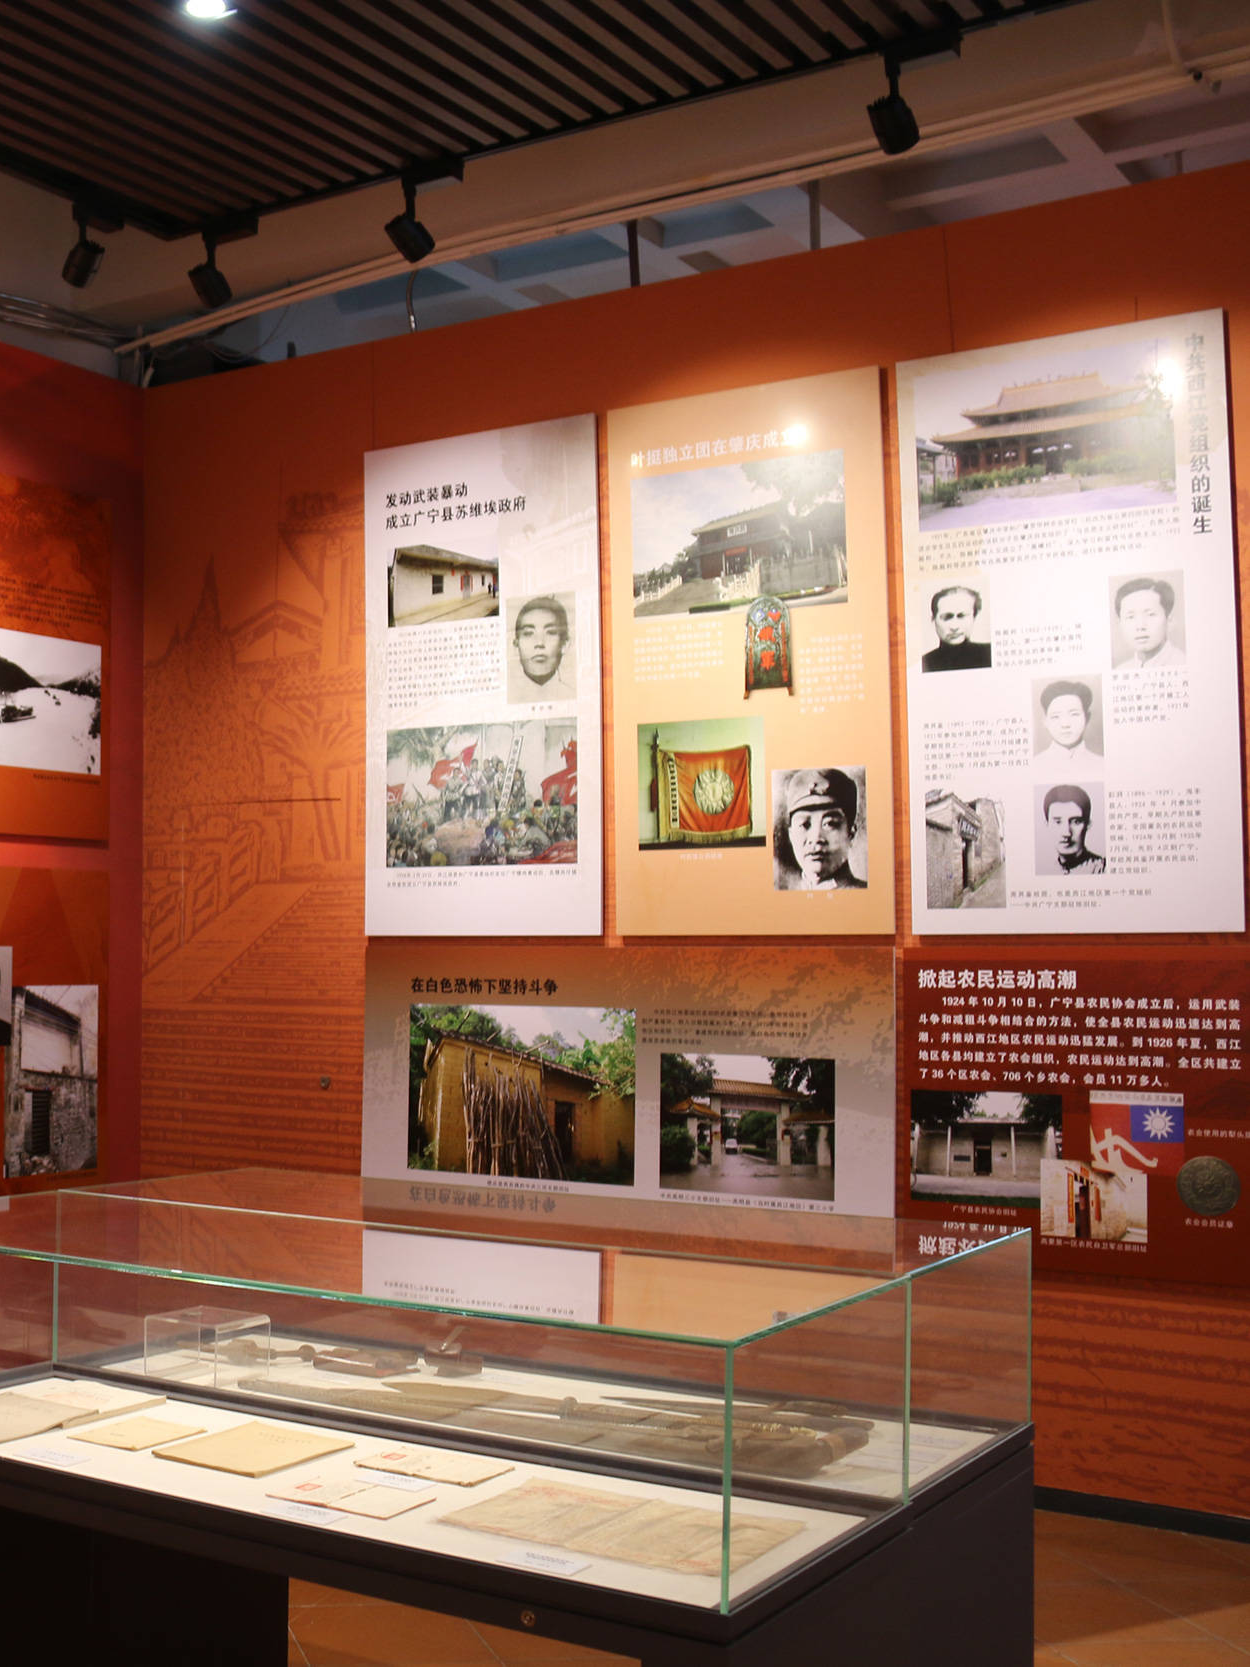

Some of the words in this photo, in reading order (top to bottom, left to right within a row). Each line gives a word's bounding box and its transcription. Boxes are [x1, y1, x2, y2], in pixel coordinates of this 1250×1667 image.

[386, 481, 468, 508] 发动武装暴动
[386, 495, 527, 530] 成立广宁县苏维埃政府
[411, 976, 558, 996] 在白色恐怖下坚持斗争
[918, 968, 1078, 990] 掀起农民运动高潮
